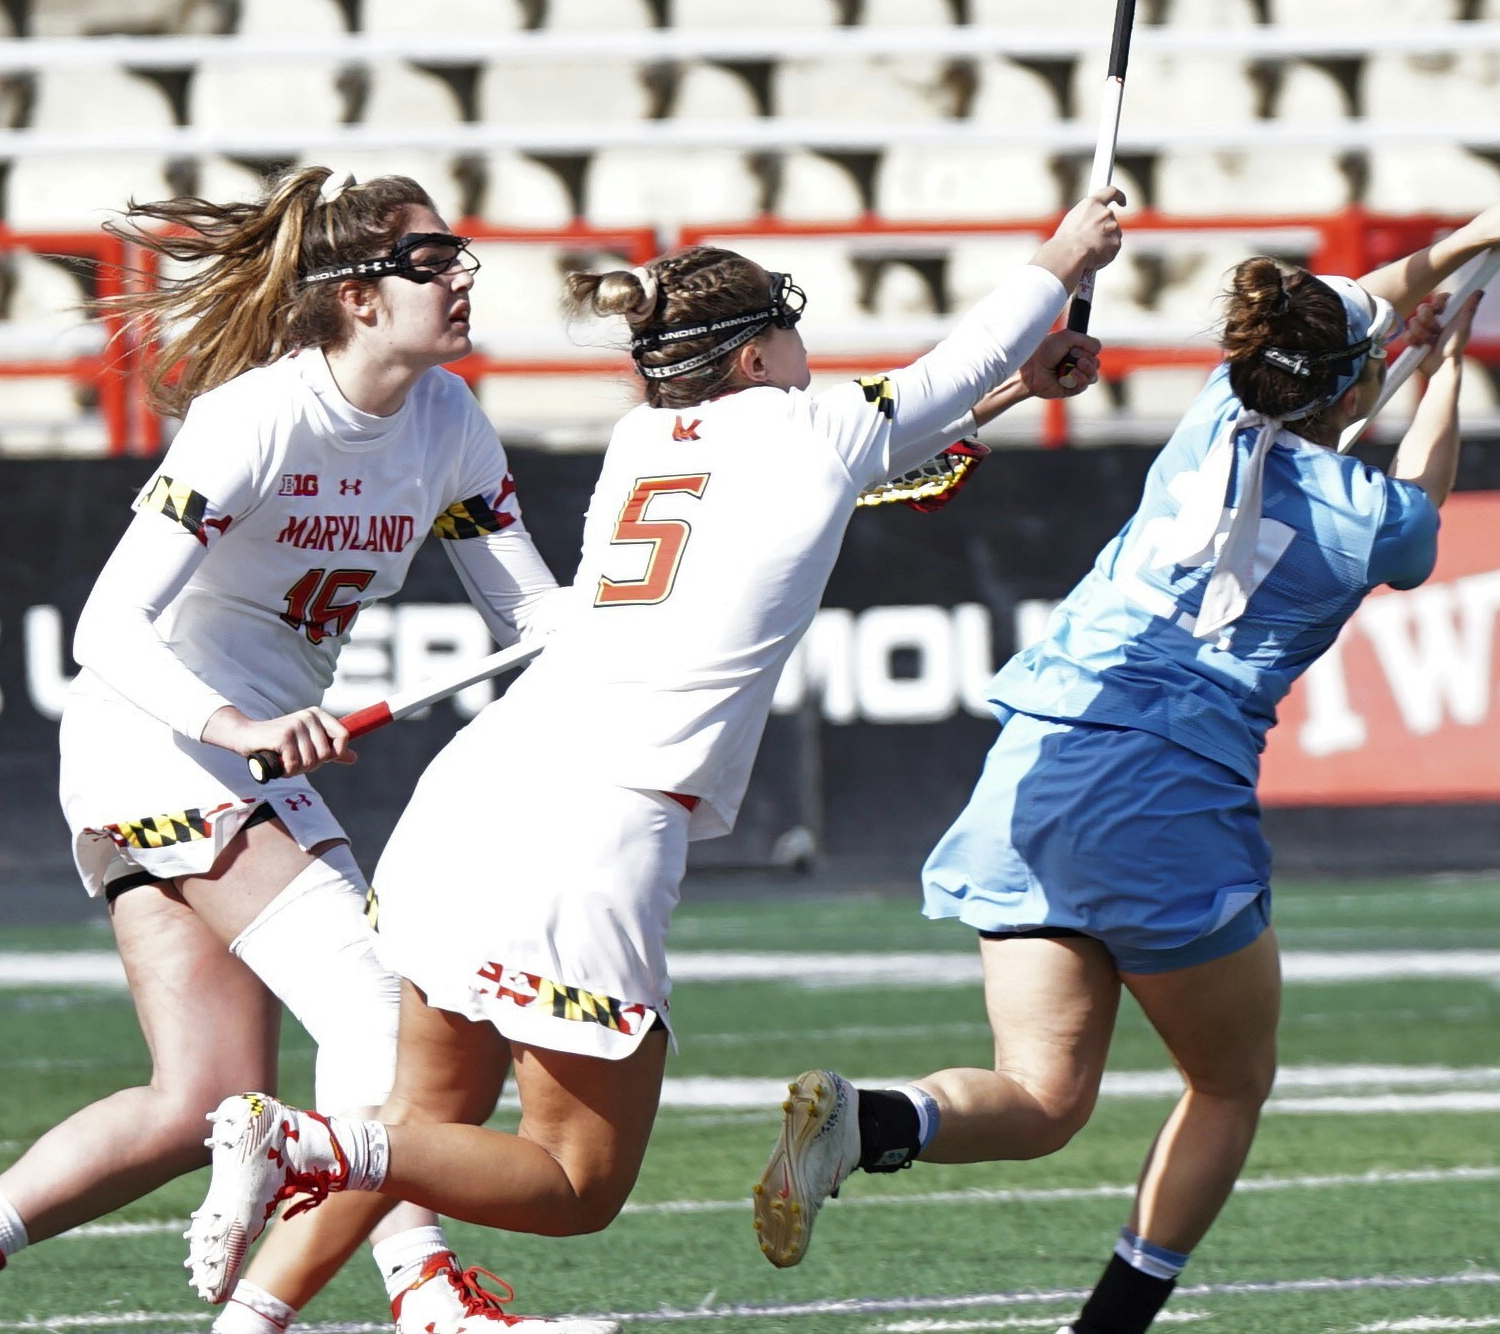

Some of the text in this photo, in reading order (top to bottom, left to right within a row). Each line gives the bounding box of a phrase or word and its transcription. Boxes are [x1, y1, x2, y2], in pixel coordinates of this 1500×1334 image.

[658, 311, 769, 341] UNDER ARMOUR
[276, 515, 416, 553] MARYLAND
[593, 471, 711, 608] 5
